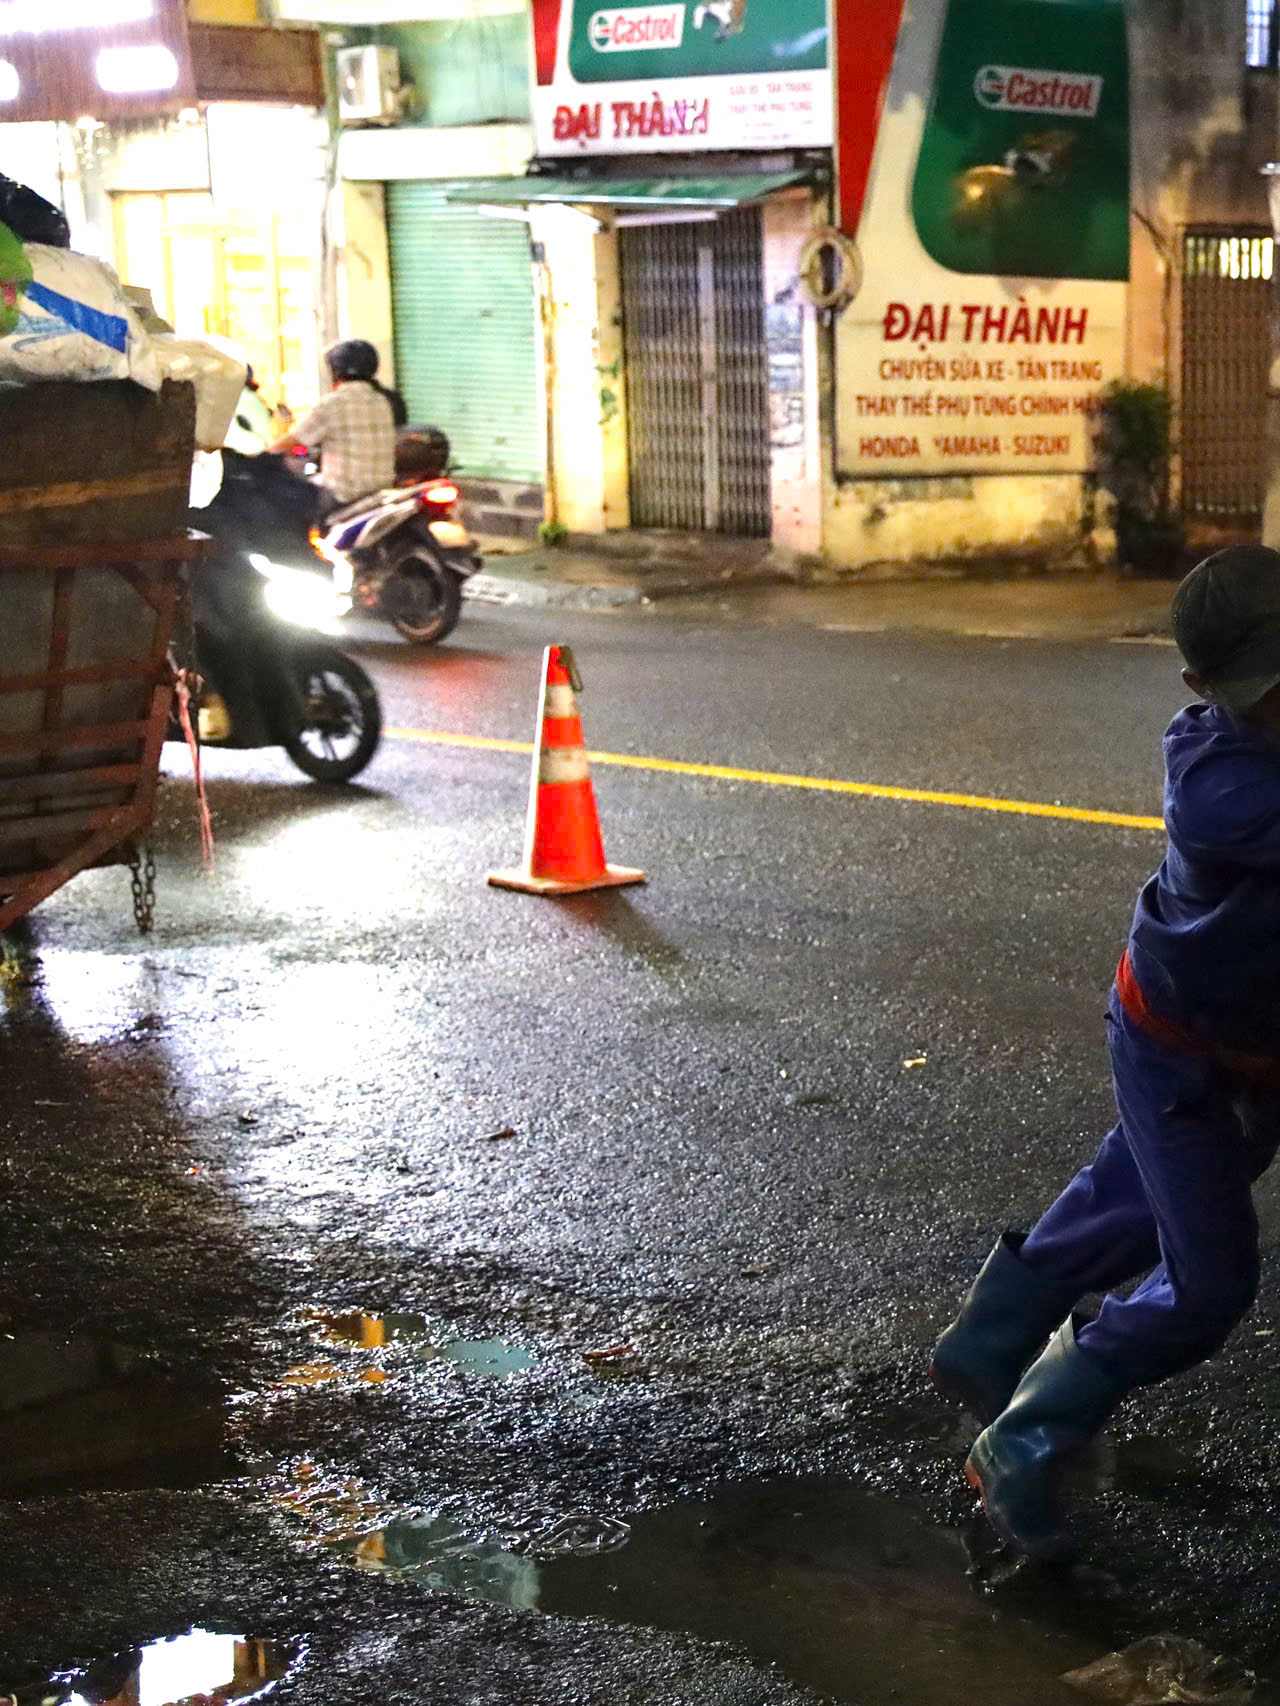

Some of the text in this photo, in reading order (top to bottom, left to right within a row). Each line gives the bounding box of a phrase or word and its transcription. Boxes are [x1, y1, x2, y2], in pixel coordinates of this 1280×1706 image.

[612, 12, 677, 45] Castrol
[1007, 72, 1094, 110] Castrol
[553, 102, 602, 147] ĐẠI
[883, 296, 1088, 351] ĐẠI THÀNH
[985, 361, 1005, 380] XE
[1051, 361, 1103, 381] TRANG
[857, 396, 898, 416] THAY
[859, 435, 1070, 457] HONDA YAMAHA SUZUKI
